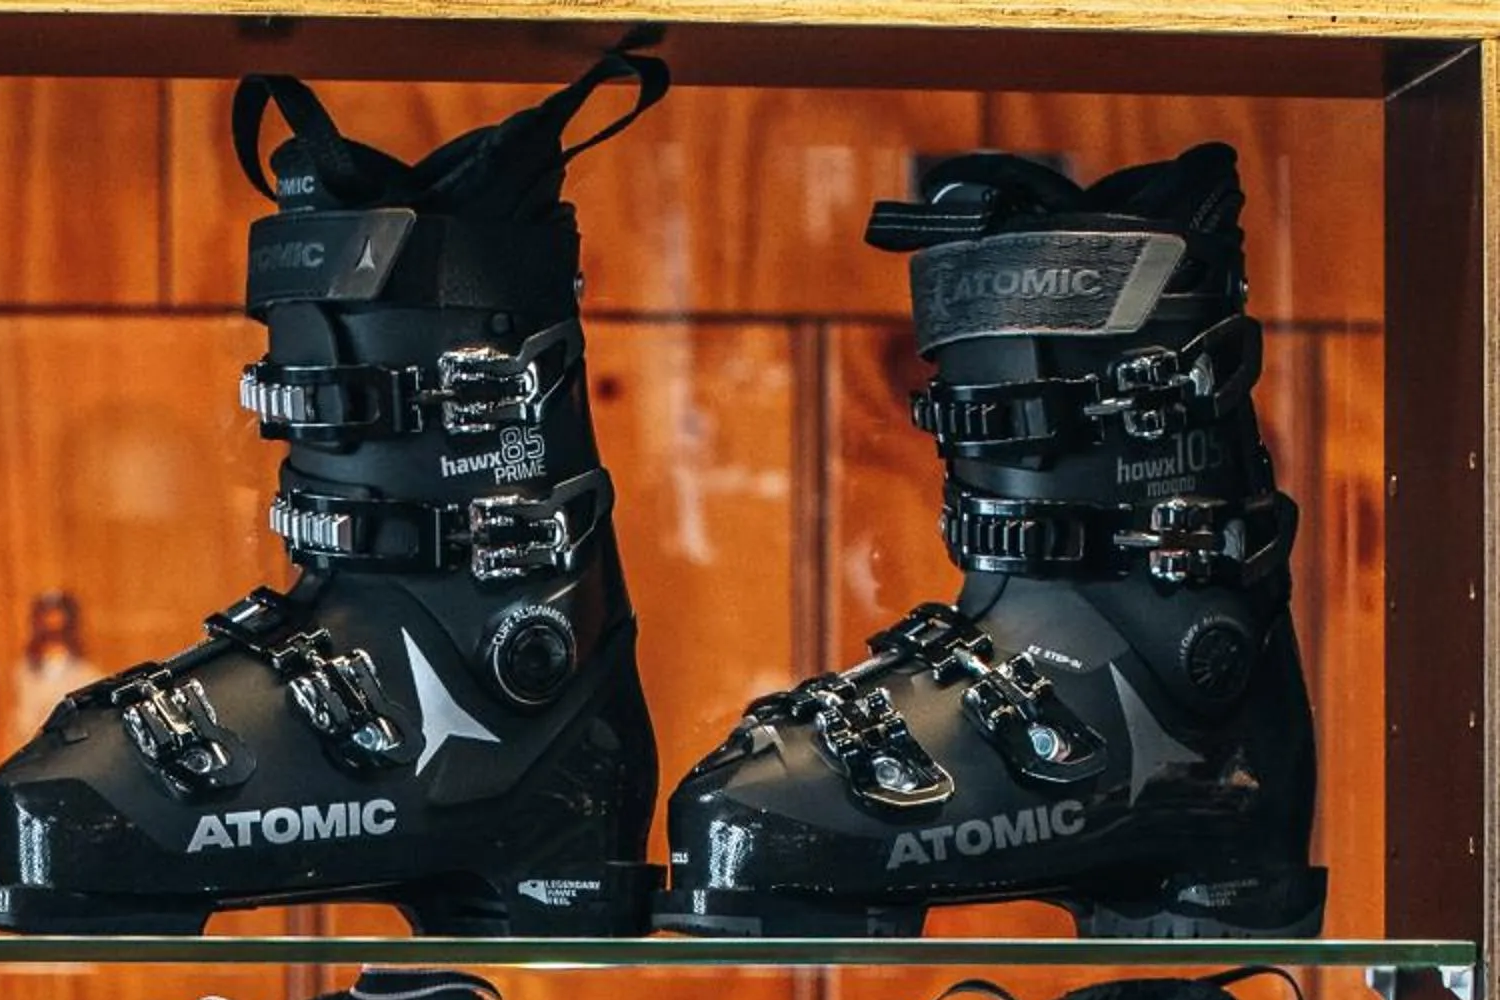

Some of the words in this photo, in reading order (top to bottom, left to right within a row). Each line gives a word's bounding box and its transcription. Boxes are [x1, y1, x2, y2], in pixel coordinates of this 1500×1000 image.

[952, 267, 1103, 304] ATOMIC
[494, 458, 547, 485] PRIME
[186, 798, 397, 853] ATOMIC
[885, 799, 1086, 870] ATOMIC
